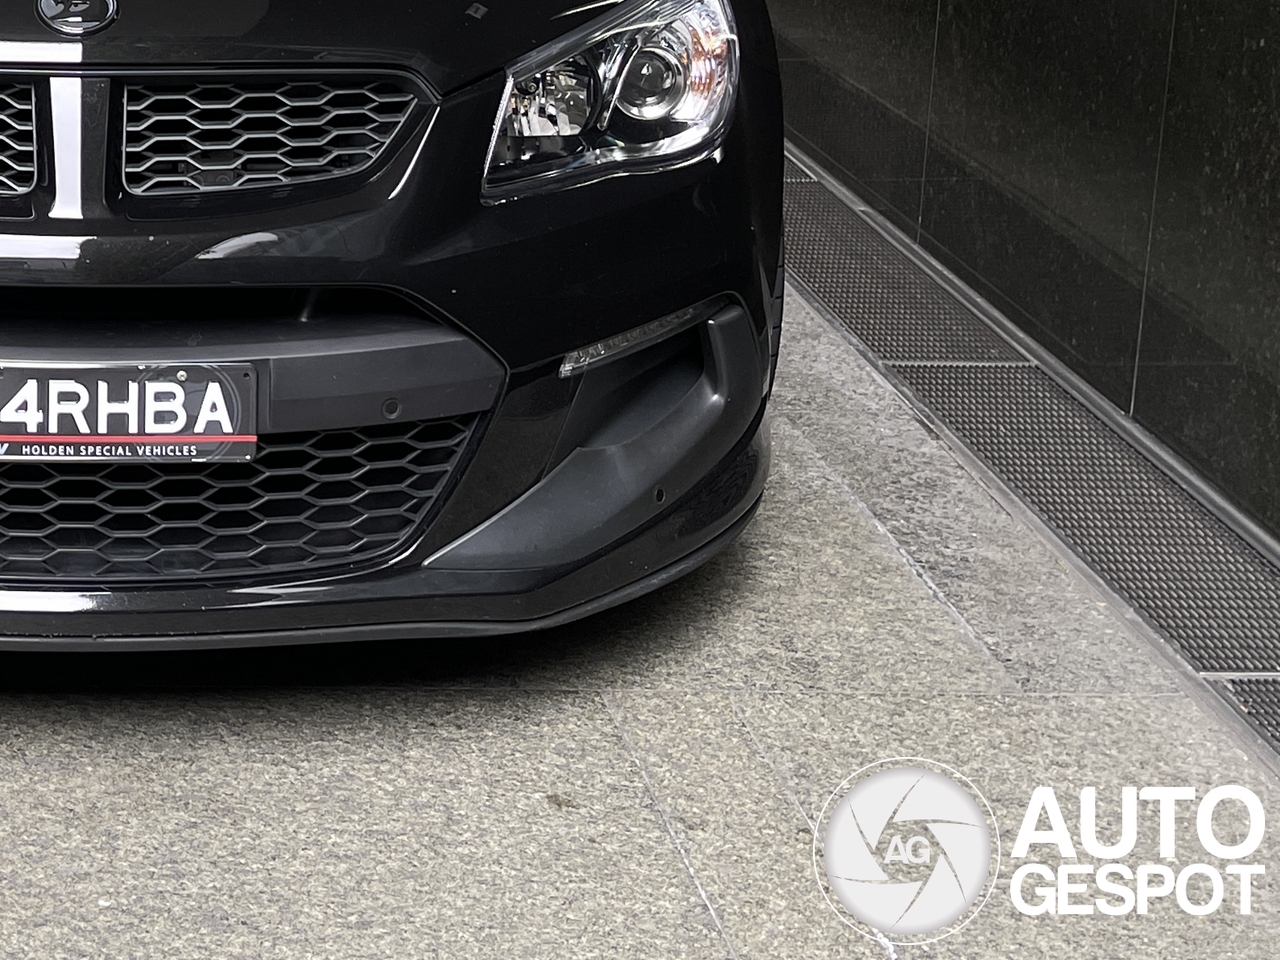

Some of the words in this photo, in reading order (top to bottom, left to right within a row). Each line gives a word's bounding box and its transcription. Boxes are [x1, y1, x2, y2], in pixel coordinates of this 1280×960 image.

[22, 444, 75, 455] HOLDEN
[79, 444, 132, 456] SPECIAL
[136, 445, 198, 456] VEHICLES
